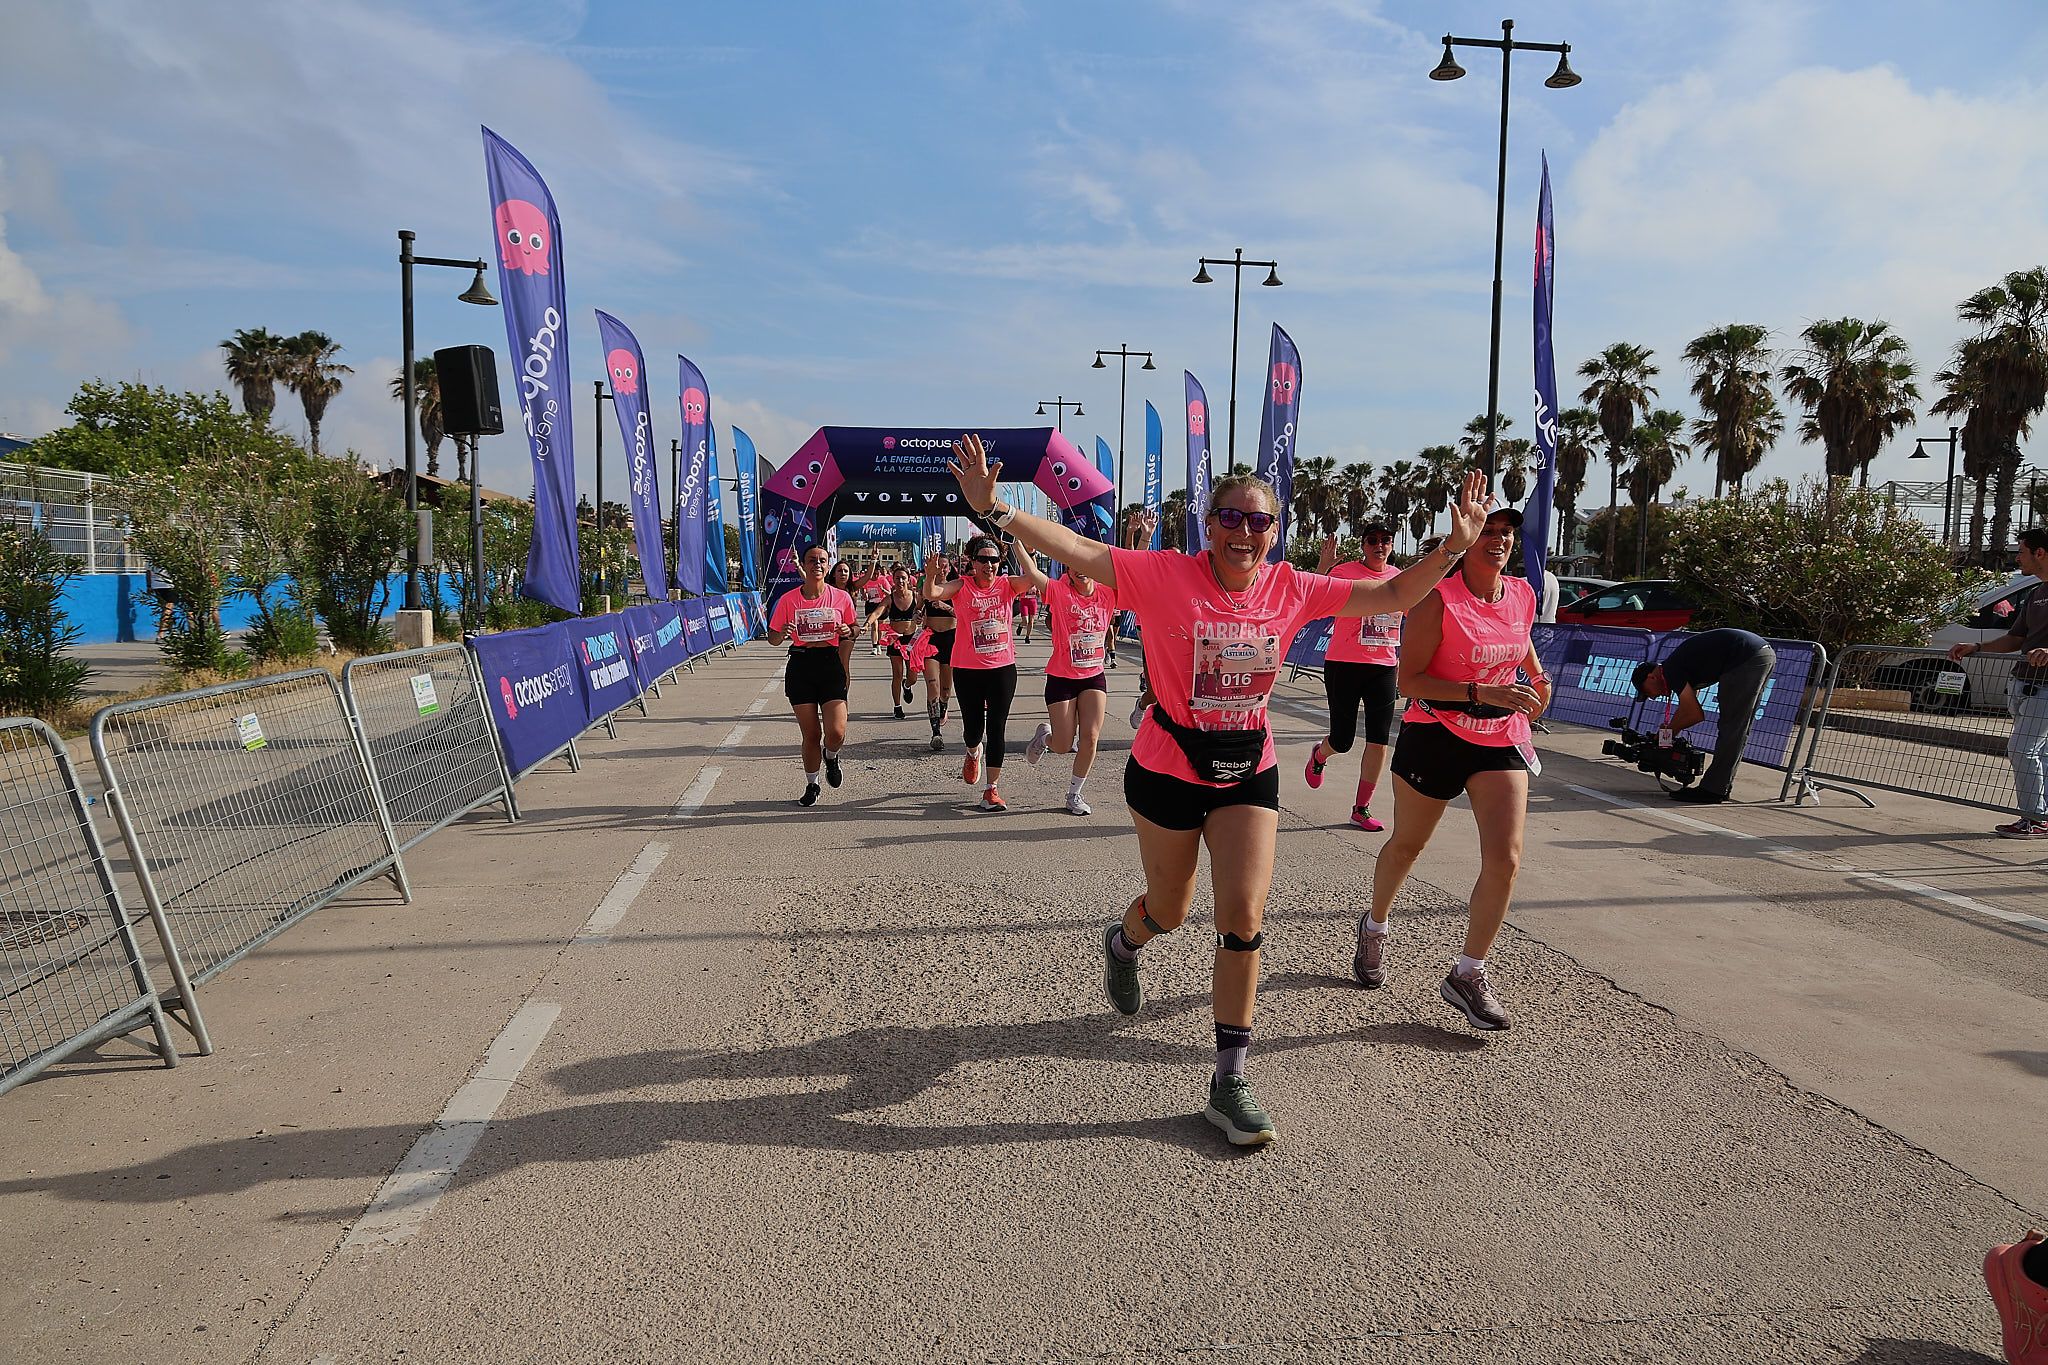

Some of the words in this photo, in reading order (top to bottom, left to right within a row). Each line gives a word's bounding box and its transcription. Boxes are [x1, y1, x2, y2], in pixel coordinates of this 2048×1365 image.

[900, 437, 952, 451] octopus
[875, 455, 888, 463] LA
[890, 454, 932, 464] ENERGÍA
[933, 456, 960, 464] PARA
[883, 465, 896, 473] LA
[898, 465, 952, 473] VELOCIDAD
[853, 492, 958, 503] VOLVO
[861, 524, 897, 539] Marlene
[1194, 620, 1268, 639] CARRERA
[985, 633, 1000, 641] 016
[1222, 673, 1252, 687] 016
[515, 673, 553, 708] octopus
[1212, 760, 1252, 769] Reebok
